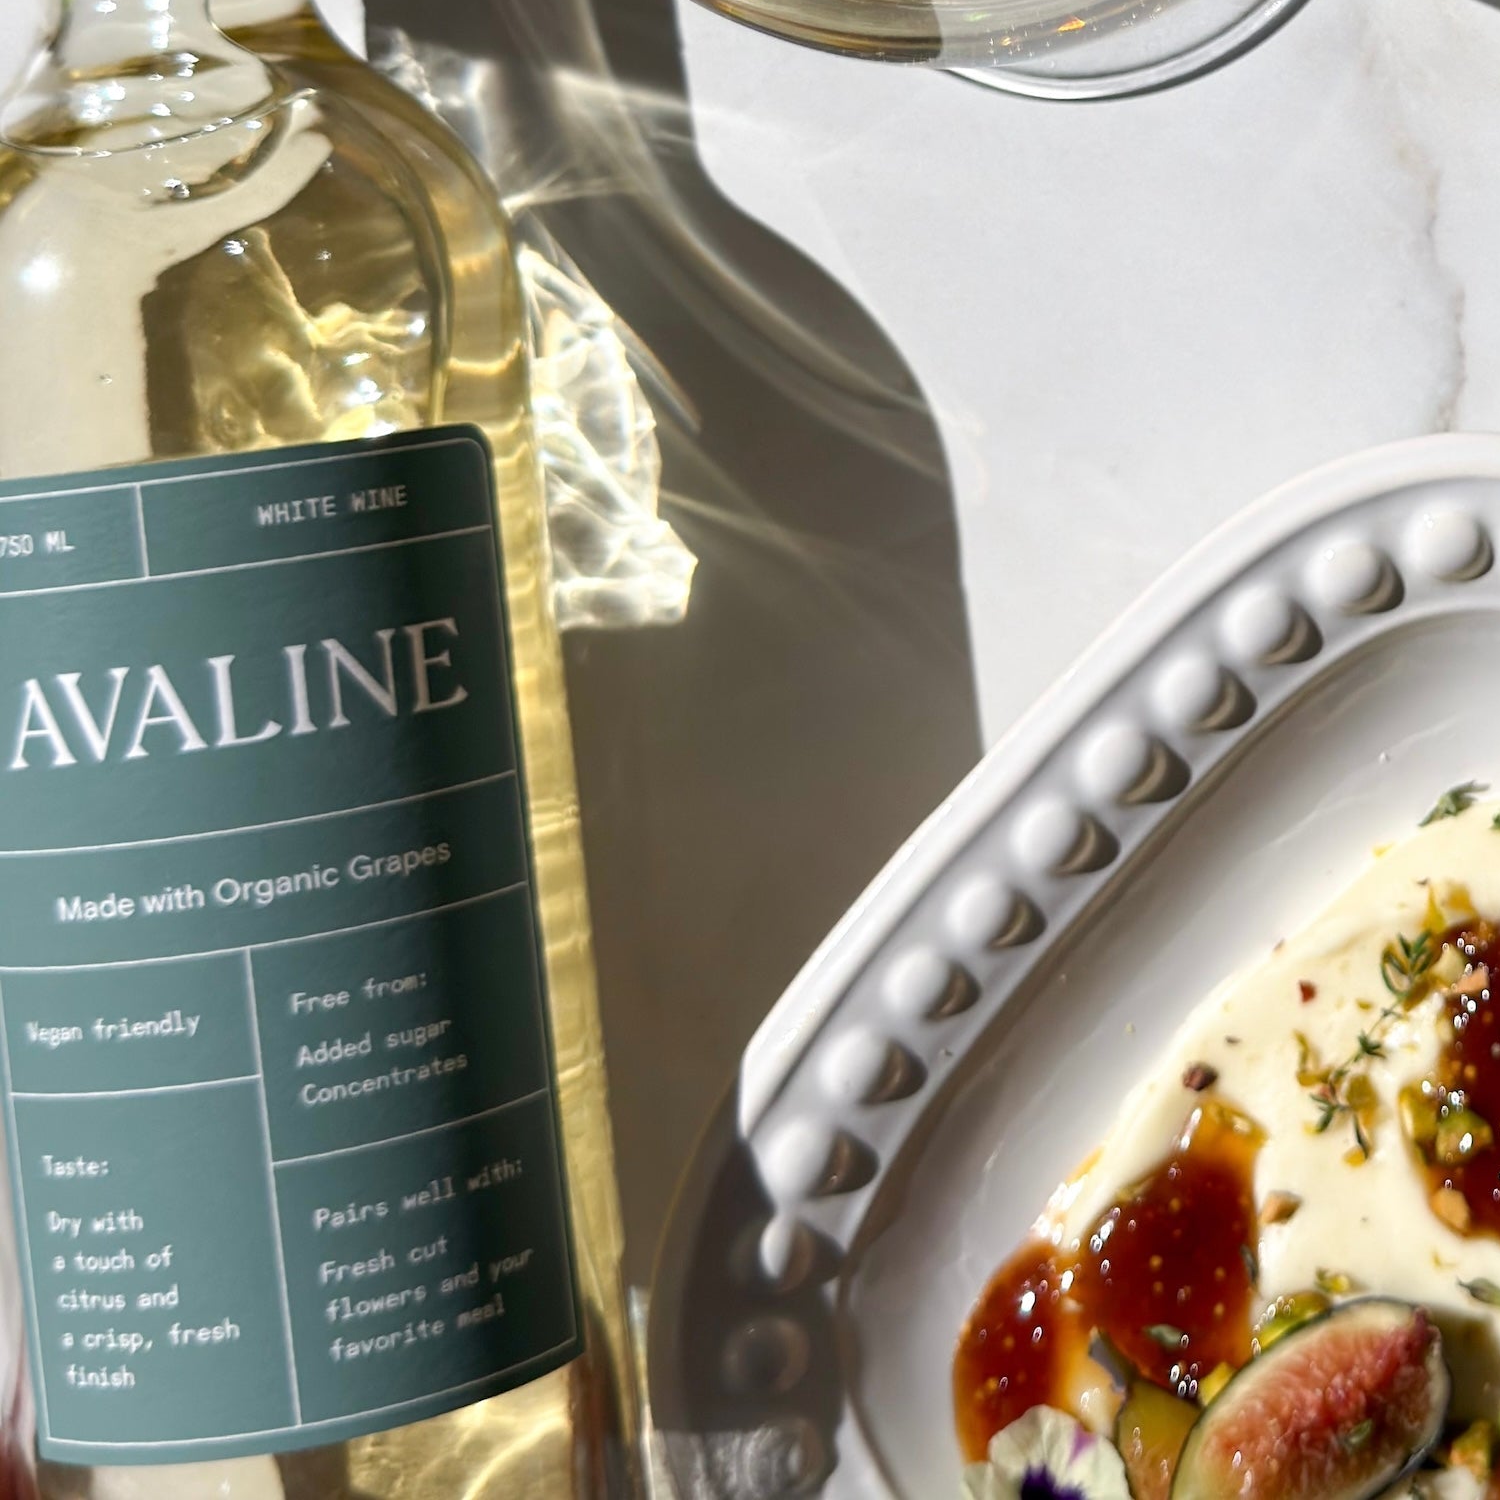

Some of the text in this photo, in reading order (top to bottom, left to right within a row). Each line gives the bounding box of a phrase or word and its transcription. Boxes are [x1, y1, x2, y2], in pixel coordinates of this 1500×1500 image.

[256, 484, 409, 526] WHITE WINE
[0, 530, 76, 558] 750 ML
[9, 616, 469, 771] AVALINE
[56, 841, 452, 922] Made with Organic Grapes
[291, 972, 428, 1014] Free from:
[26, 1009, 201, 1049] Vegan friendly
[297, 1019, 452, 1068] Added sugar
[301, 1053, 469, 1107] Concentrates
[41, 1154, 110, 1177] Taste:
[313, 1158, 524, 1230] Pairs well with:
[47, 1208, 144, 1238] Dry with
[53, 1244, 173, 1273] a touch of
[319, 1235, 448, 1284] Fresh cut
[57, 1283, 180, 1310] citrus and
[326, 1248, 535, 1322] flowers and your
[61, 1317, 241, 1356] a crisp, fresh
[330, 1293, 506, 1362] favorite meal
[66, 1363, 136, 1388] finish
